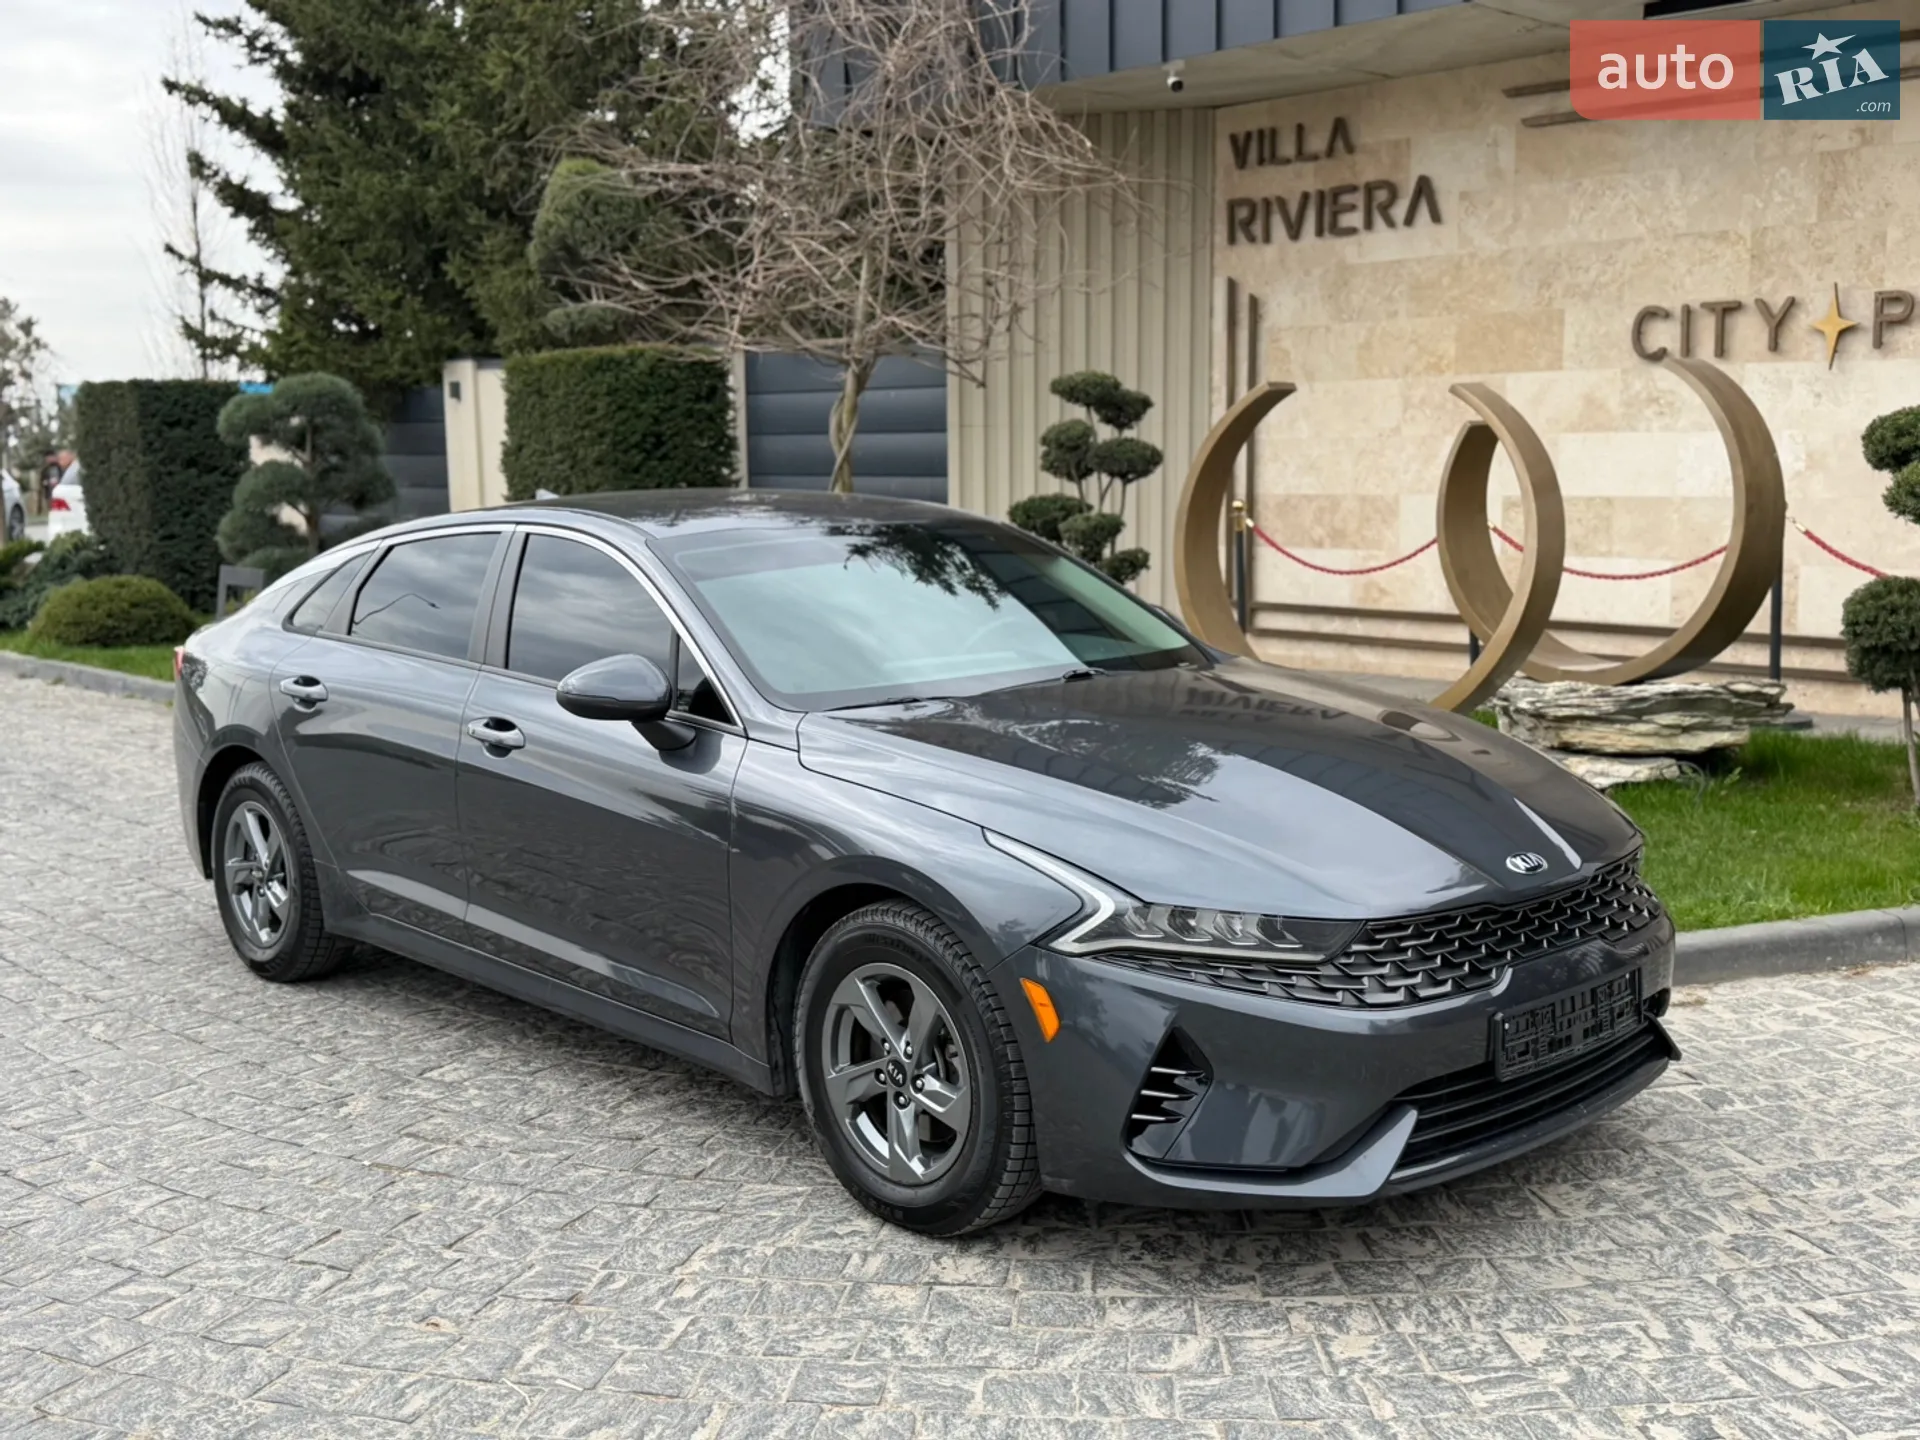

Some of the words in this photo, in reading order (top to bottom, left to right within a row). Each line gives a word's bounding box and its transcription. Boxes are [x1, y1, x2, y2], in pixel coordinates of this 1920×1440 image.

[1229, 116, 1356, 170] VILLA
[1227, 174, 1442, 245] RIVIERA
[1631, 296, 1796, 361] CITY
[1508, 853, 1544, 871] KIA
[887, 1062, 903, 1085] KIA
